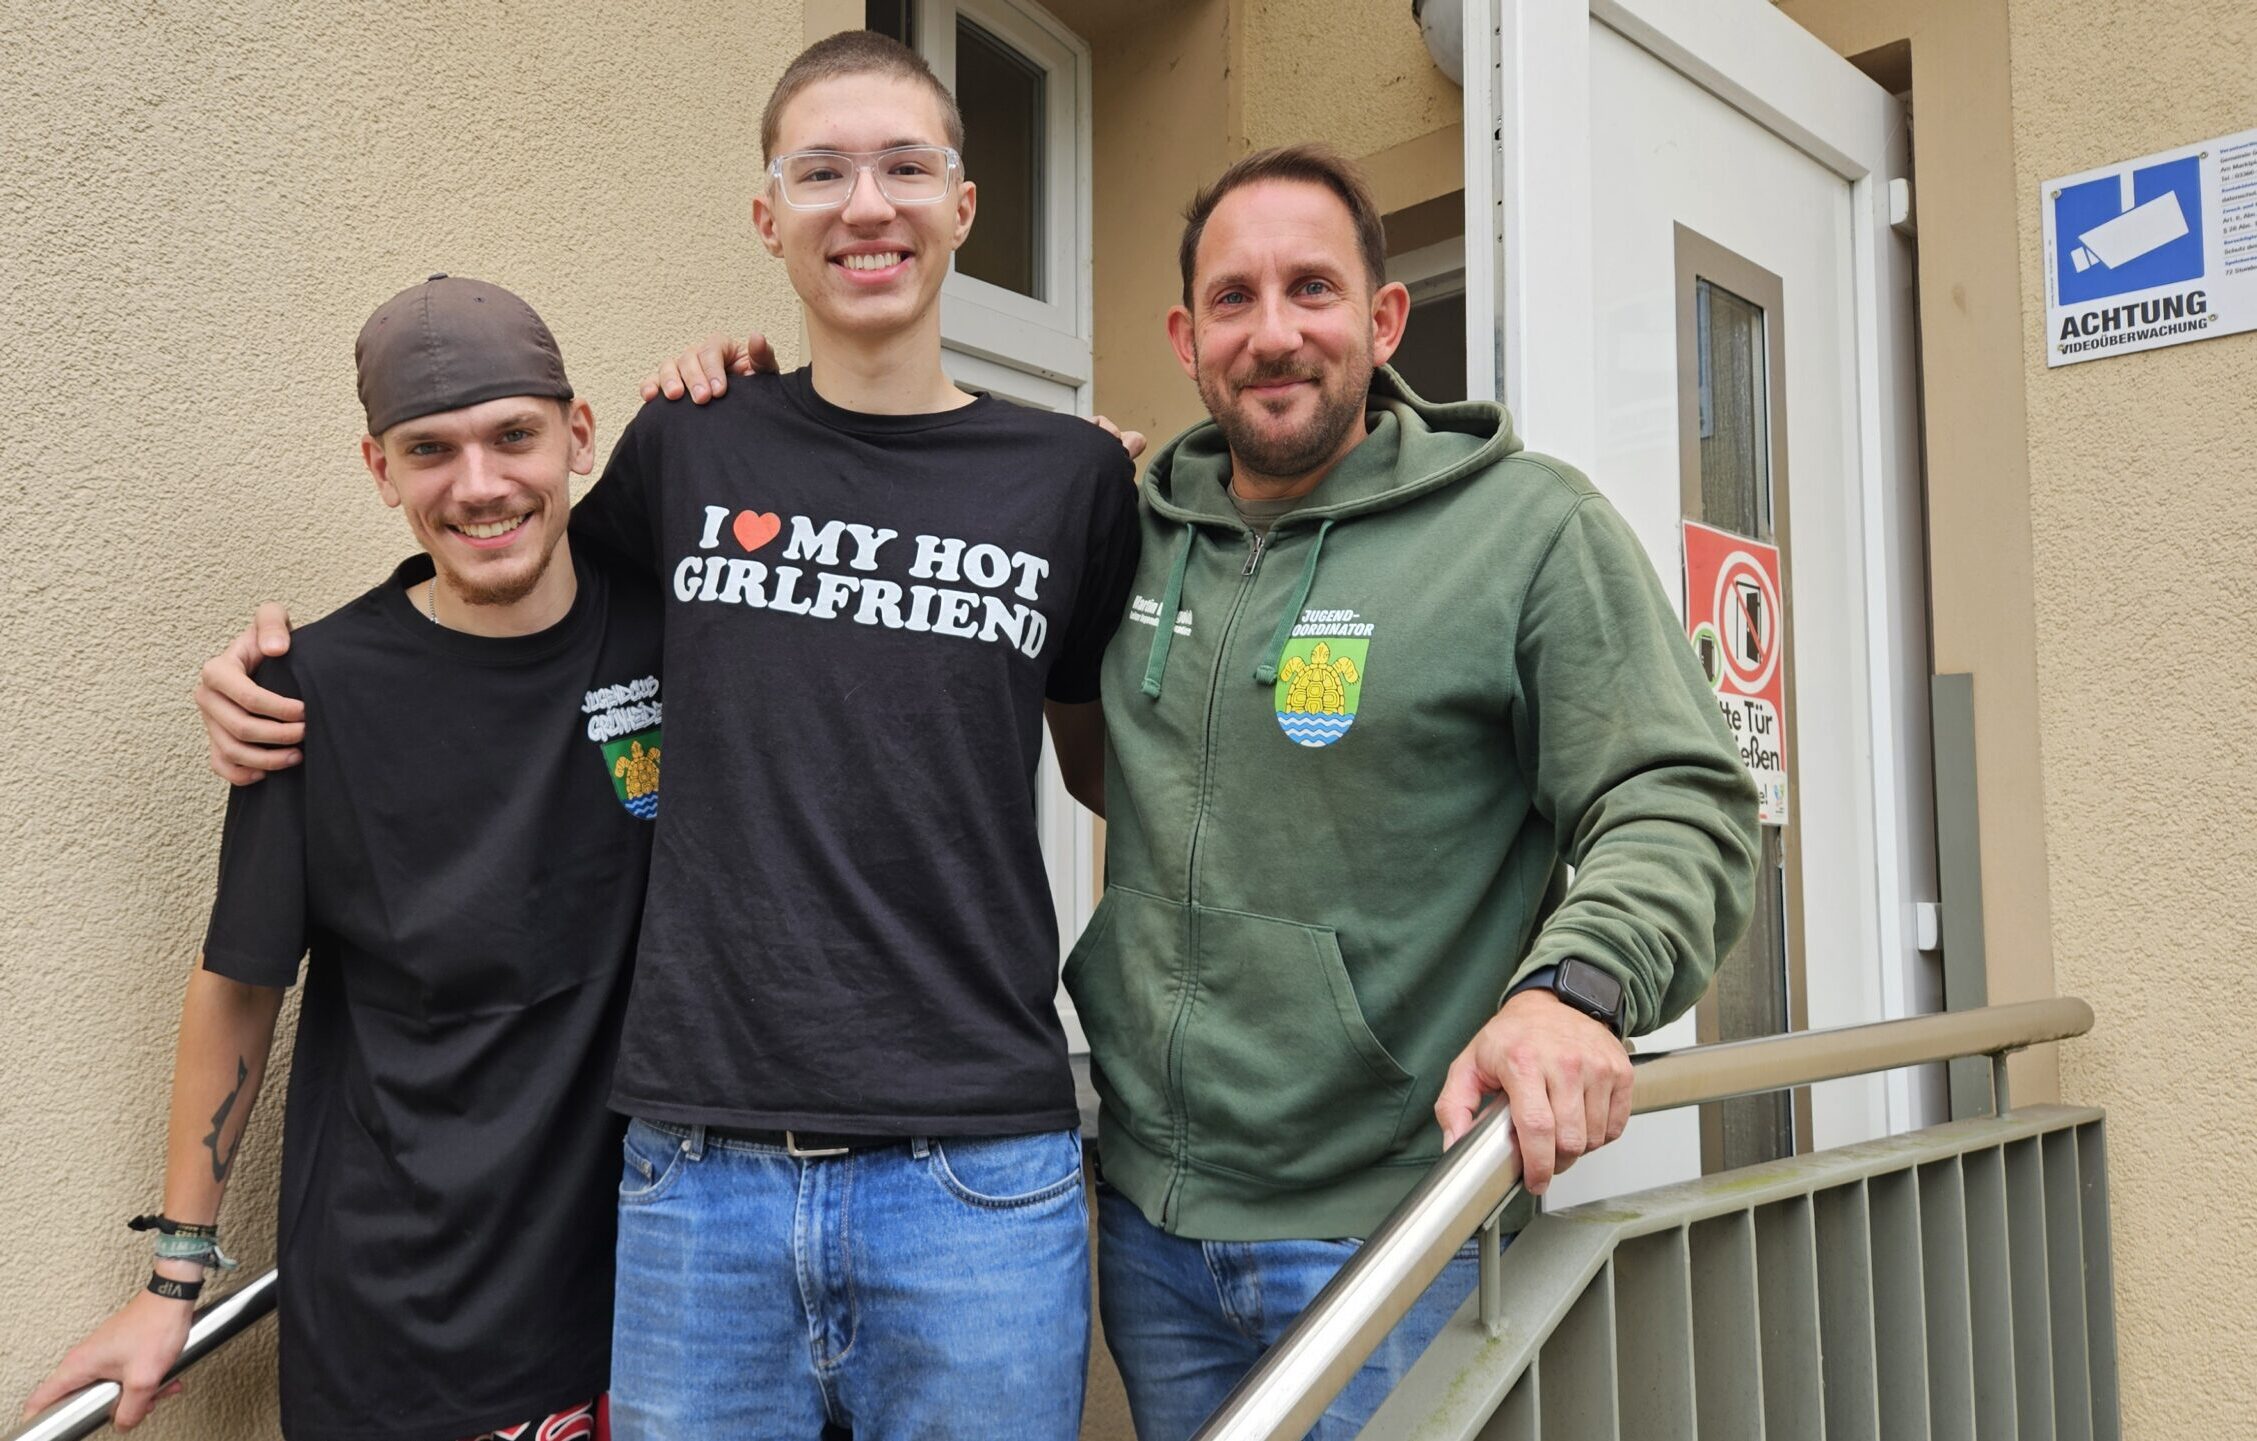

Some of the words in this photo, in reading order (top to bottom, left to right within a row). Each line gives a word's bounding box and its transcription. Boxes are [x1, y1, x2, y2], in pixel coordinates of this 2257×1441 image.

[2060, 290, 2207, 340] ACHTUNG
[2060, 318, 2207, 355] VIDEOÜBERWACHUNG
[699, 505, 730, 549] I
[782, 515, 898, 571] MY
[908, 534, 1049, 601] HOT
[673, 556, 1048, 659] GIRLFRIEND
[1301, 609, 1360, 623] JUGEND-
[1291, 623, 1375, 637] OORDINATOR
[1744, 700, 1772, 735] Tür
